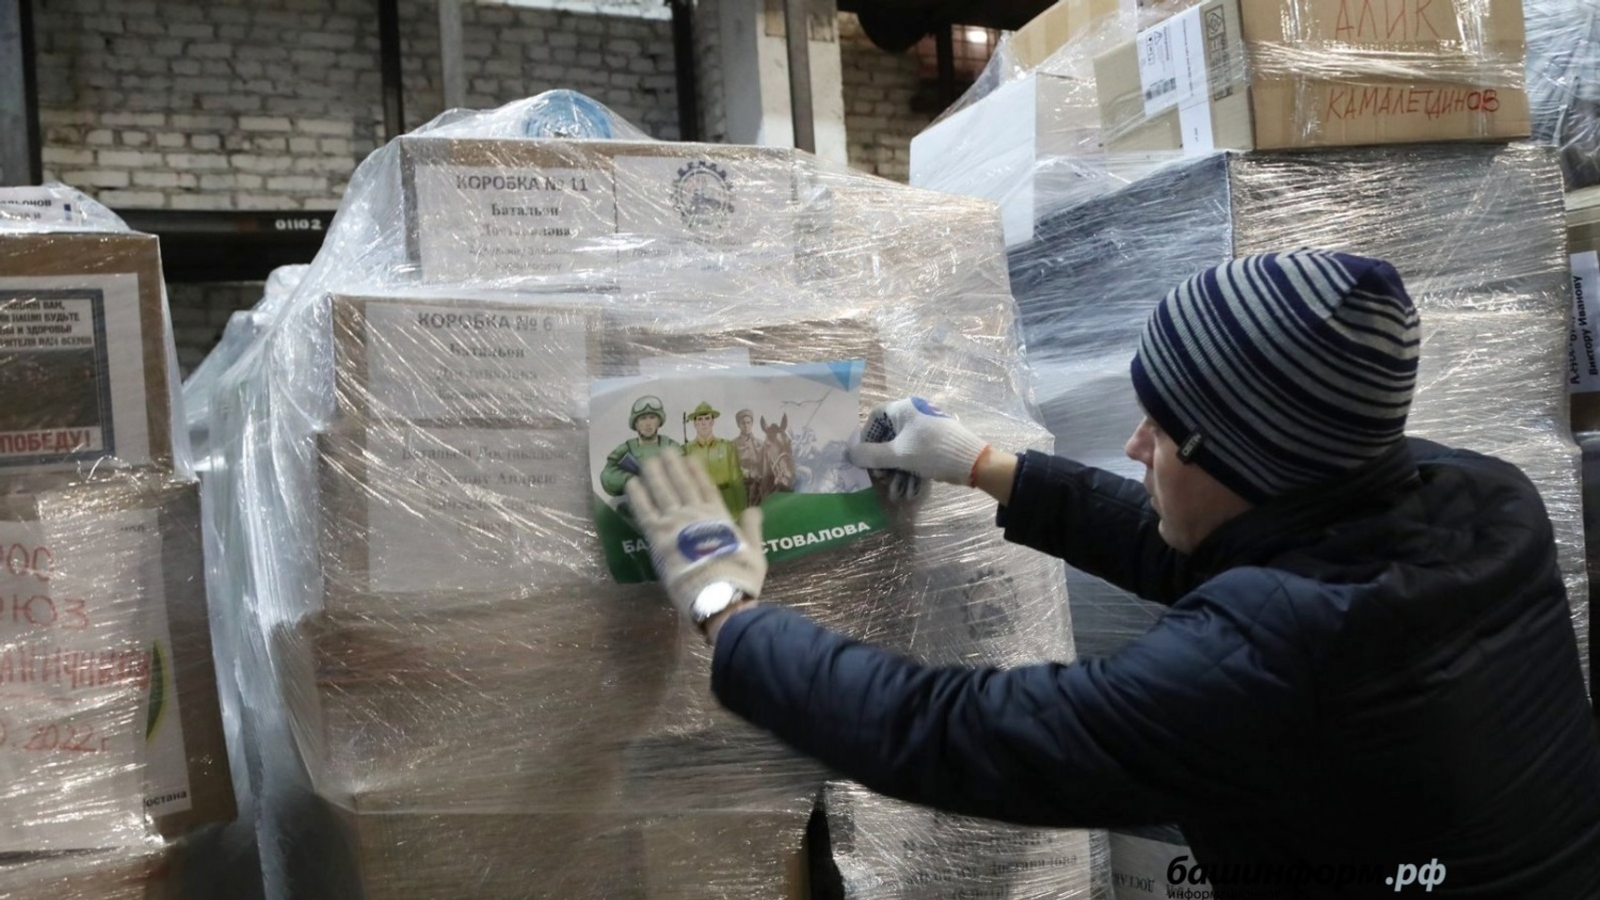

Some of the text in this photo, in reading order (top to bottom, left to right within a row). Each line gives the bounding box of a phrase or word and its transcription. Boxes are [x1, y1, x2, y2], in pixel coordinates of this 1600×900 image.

[1335, 0, 1440, 40] АЛИК
[456, 175, 539, 191] КОРОБКА
[571, 177, 588, 192] 11
[491, 203, 559, 217] Батальон
[275, 219, 322, 230] 01102
[1573, 275, 1588, 326] Иванову
[44, 311, 80, 323] БУДЬТЕ
[417, 312, 511, 330] КОРОБКА
[543, 316, 553, 331] 6
[1582, 328, 1598, 376] Виктору
[0, 429, 91, 453] ПОБЕДУ!
[0, 543, 53, 581] ОС
[0, 594, 89, 630] ЮЗ
